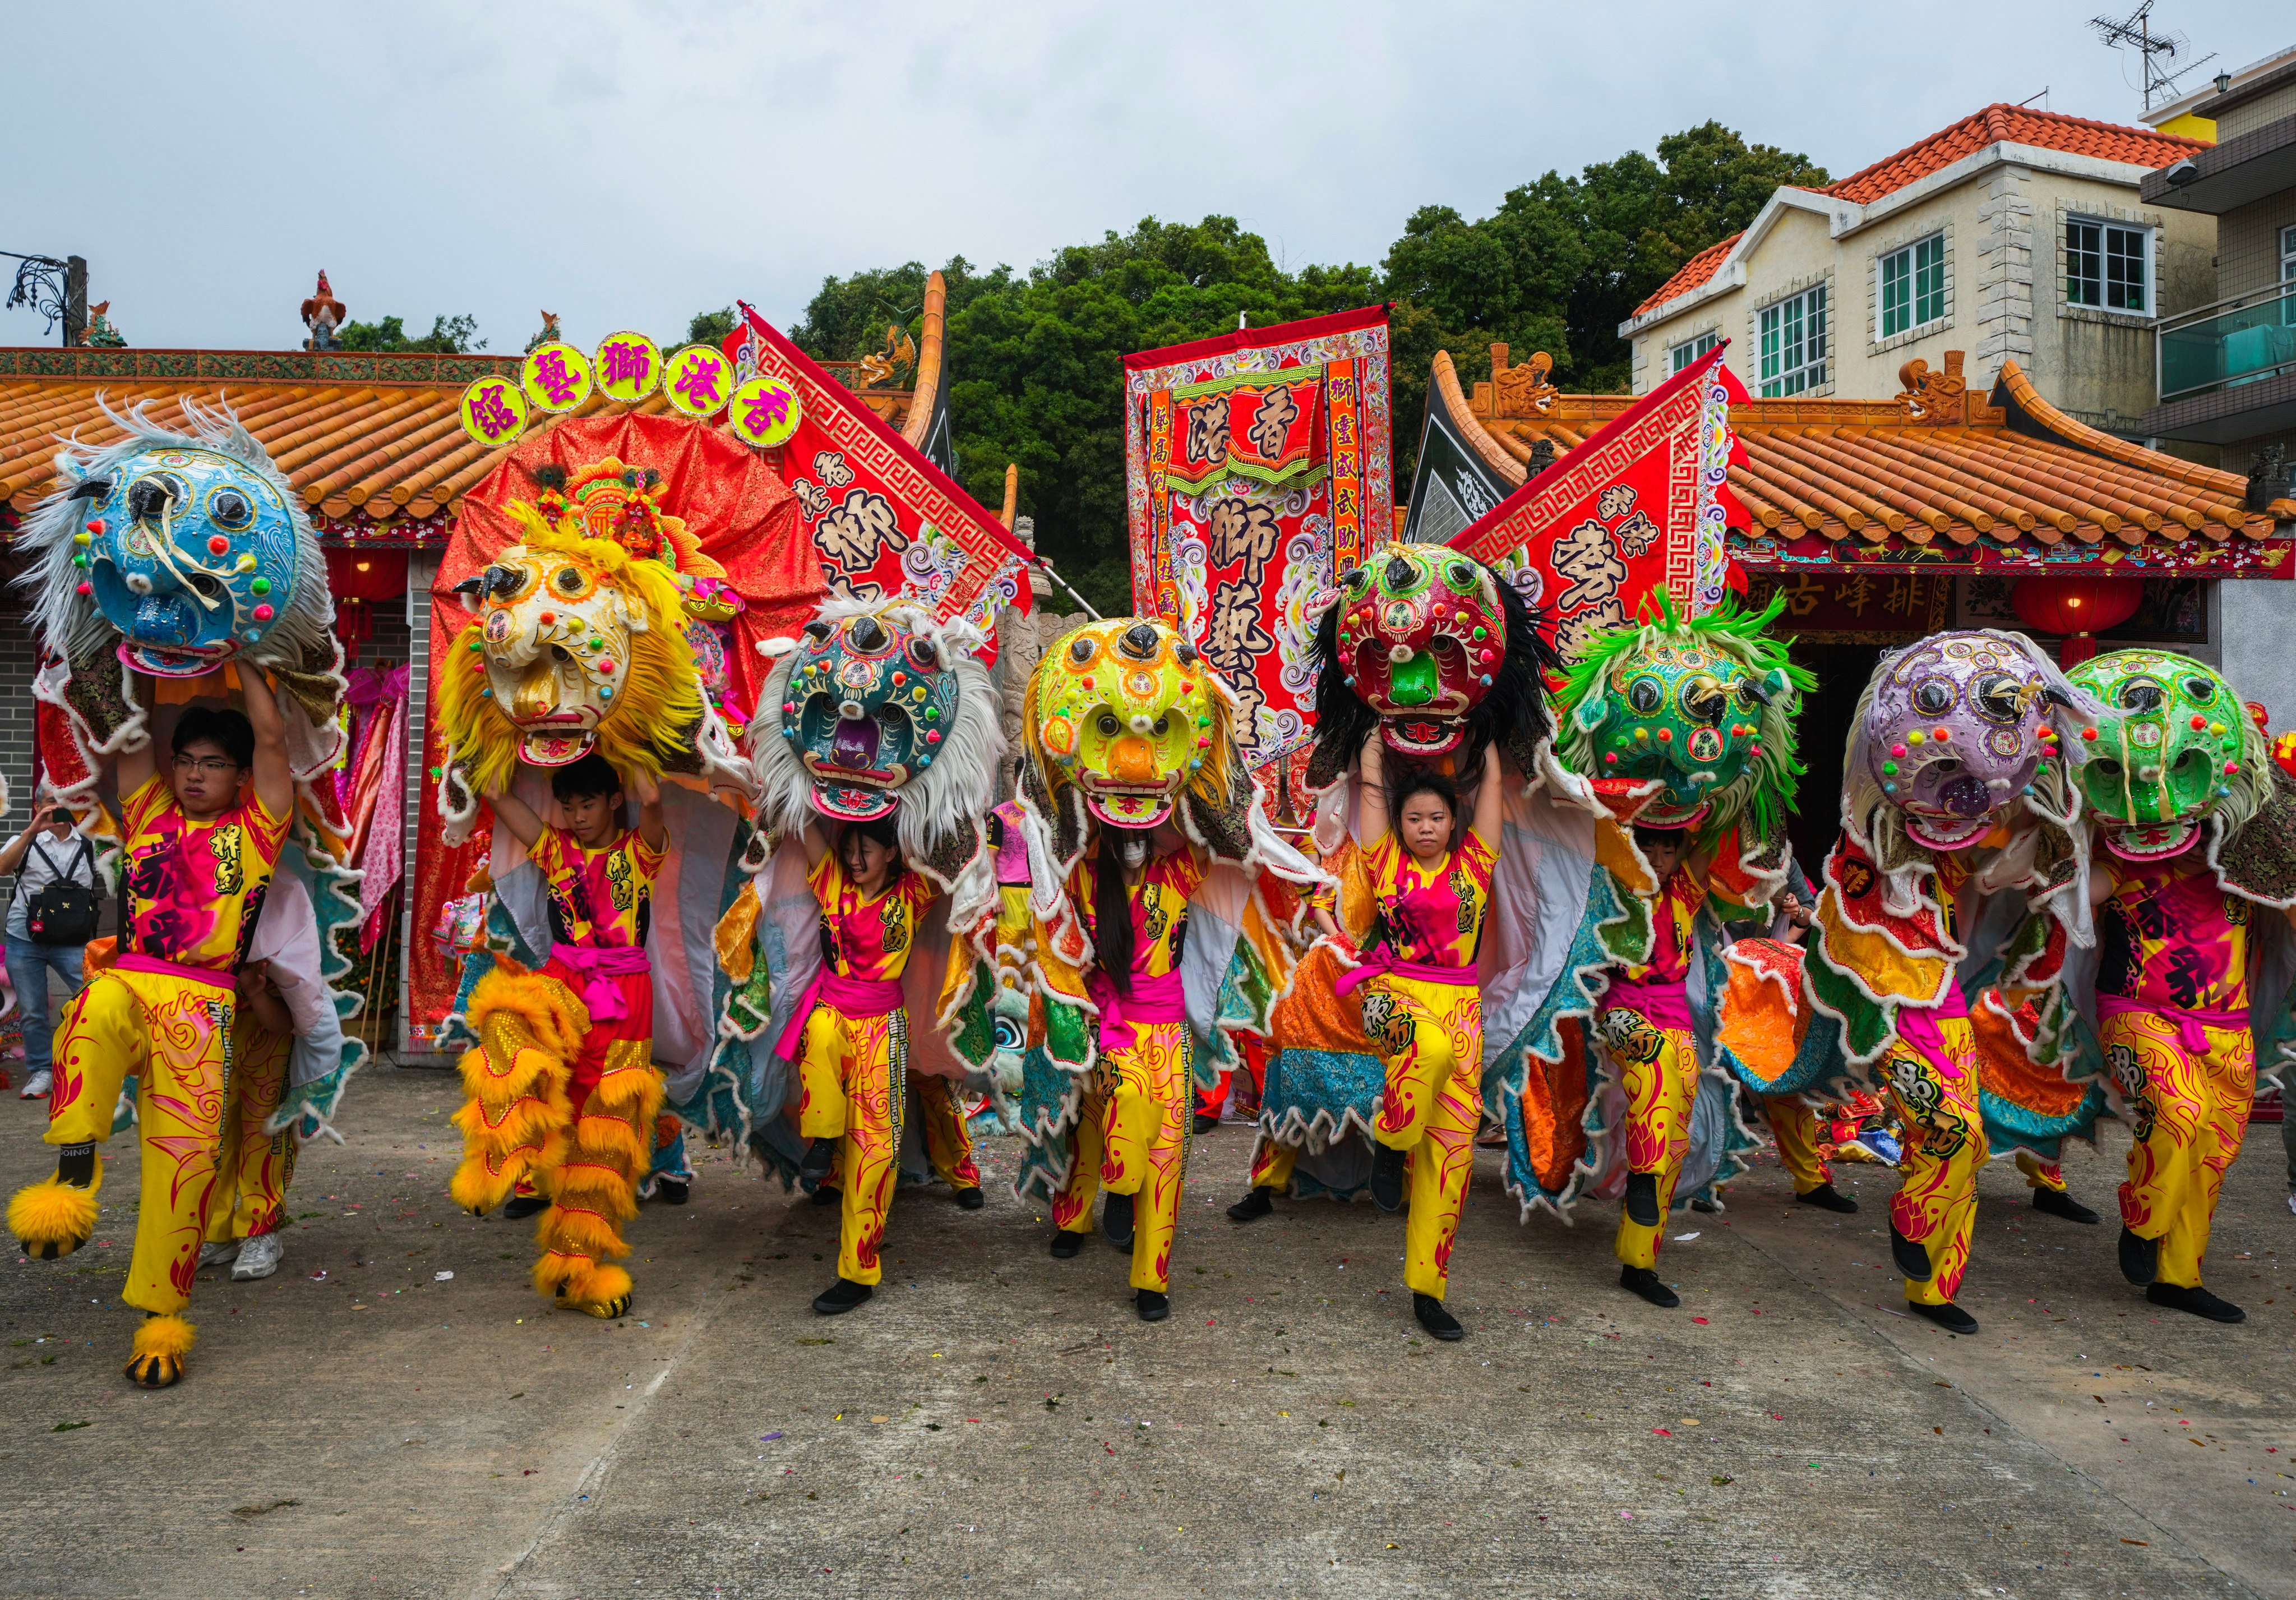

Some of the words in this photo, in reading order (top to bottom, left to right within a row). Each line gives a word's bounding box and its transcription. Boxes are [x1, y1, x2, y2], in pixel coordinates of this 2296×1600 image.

[1186, 385, 1300, 465] 香港
[1739, 572, 1925, 617] 排峰古廟
[890, 1088, 899, 1123] Dance
